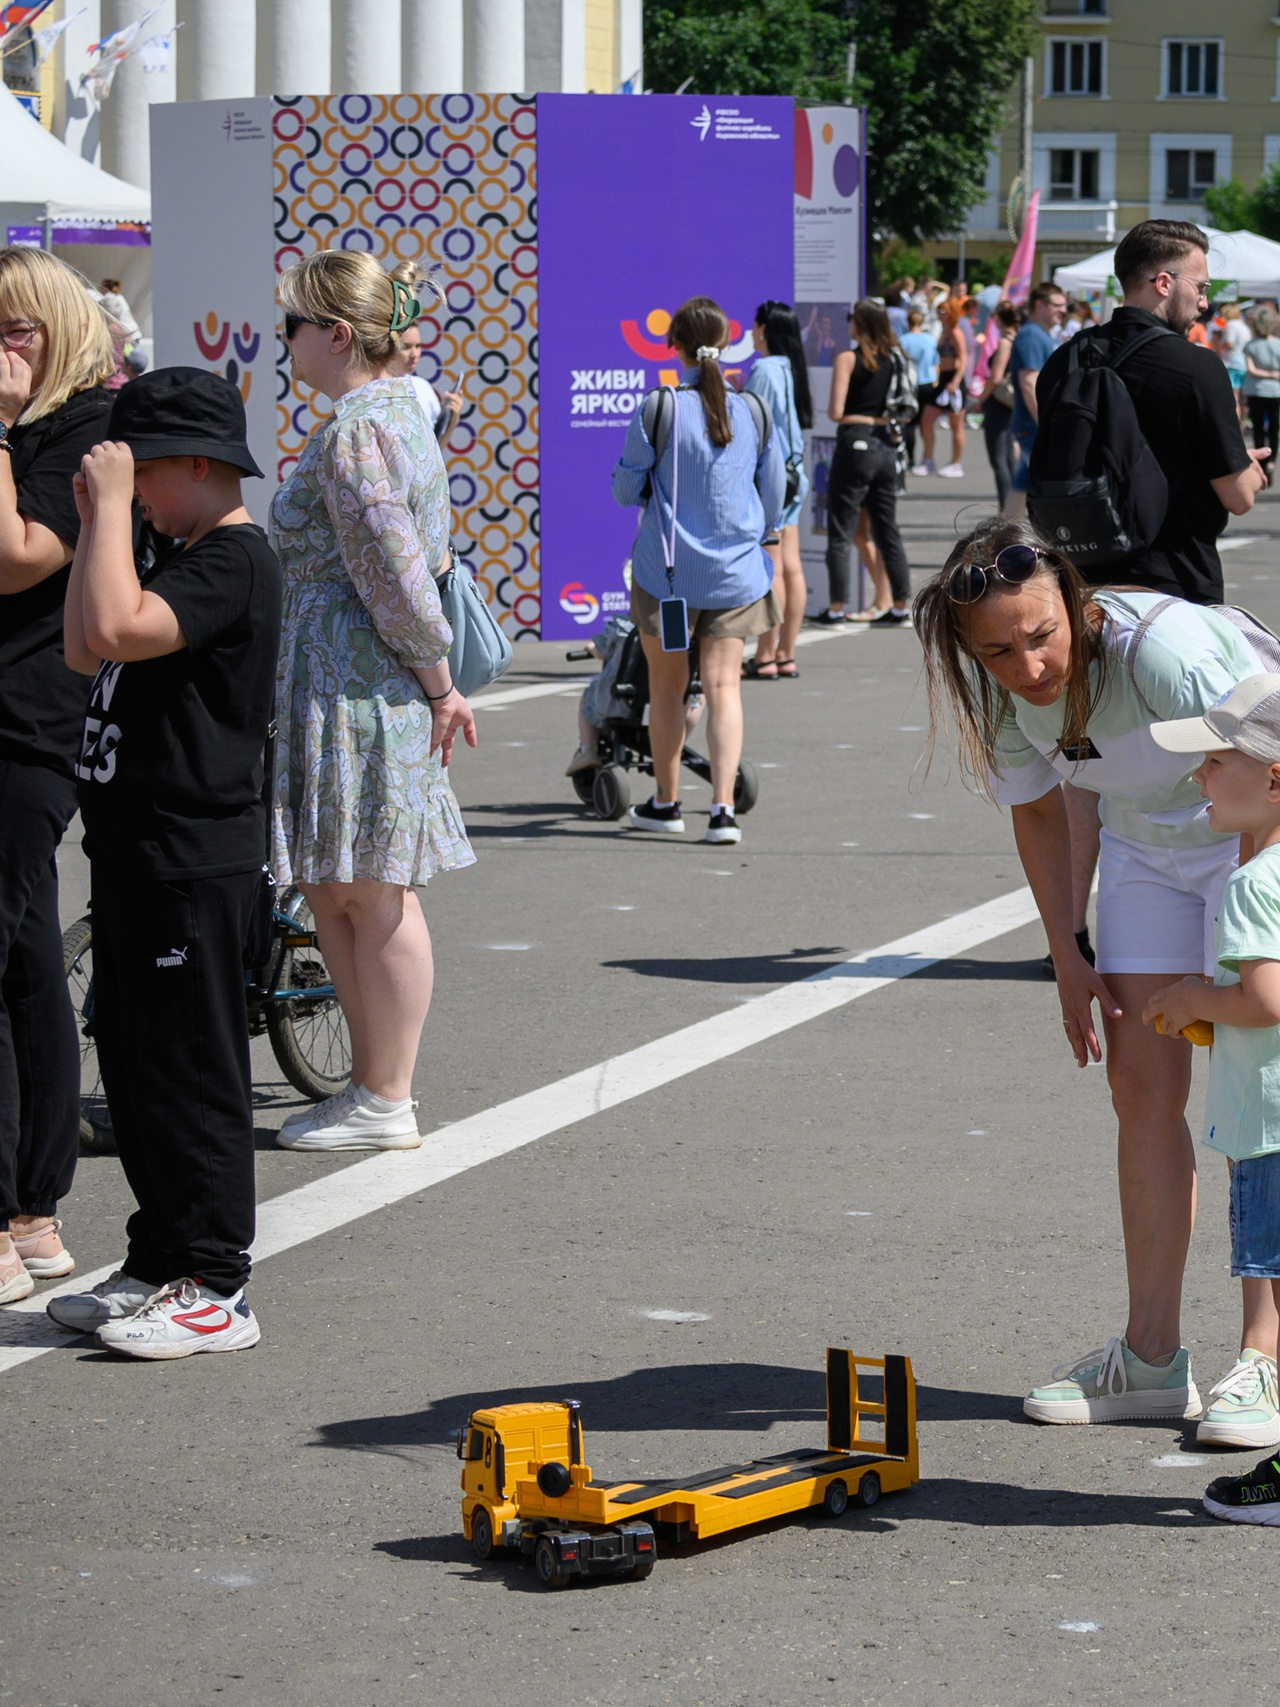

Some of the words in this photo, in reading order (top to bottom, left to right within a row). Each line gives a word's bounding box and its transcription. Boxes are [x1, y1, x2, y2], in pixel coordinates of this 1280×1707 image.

[570, 369, 645, 391] ЖИВИ
[1056, 542, 1098, 554] KING
[601, 591, 626, 602] GYM
[156, 956, 183, 968] PUMA
